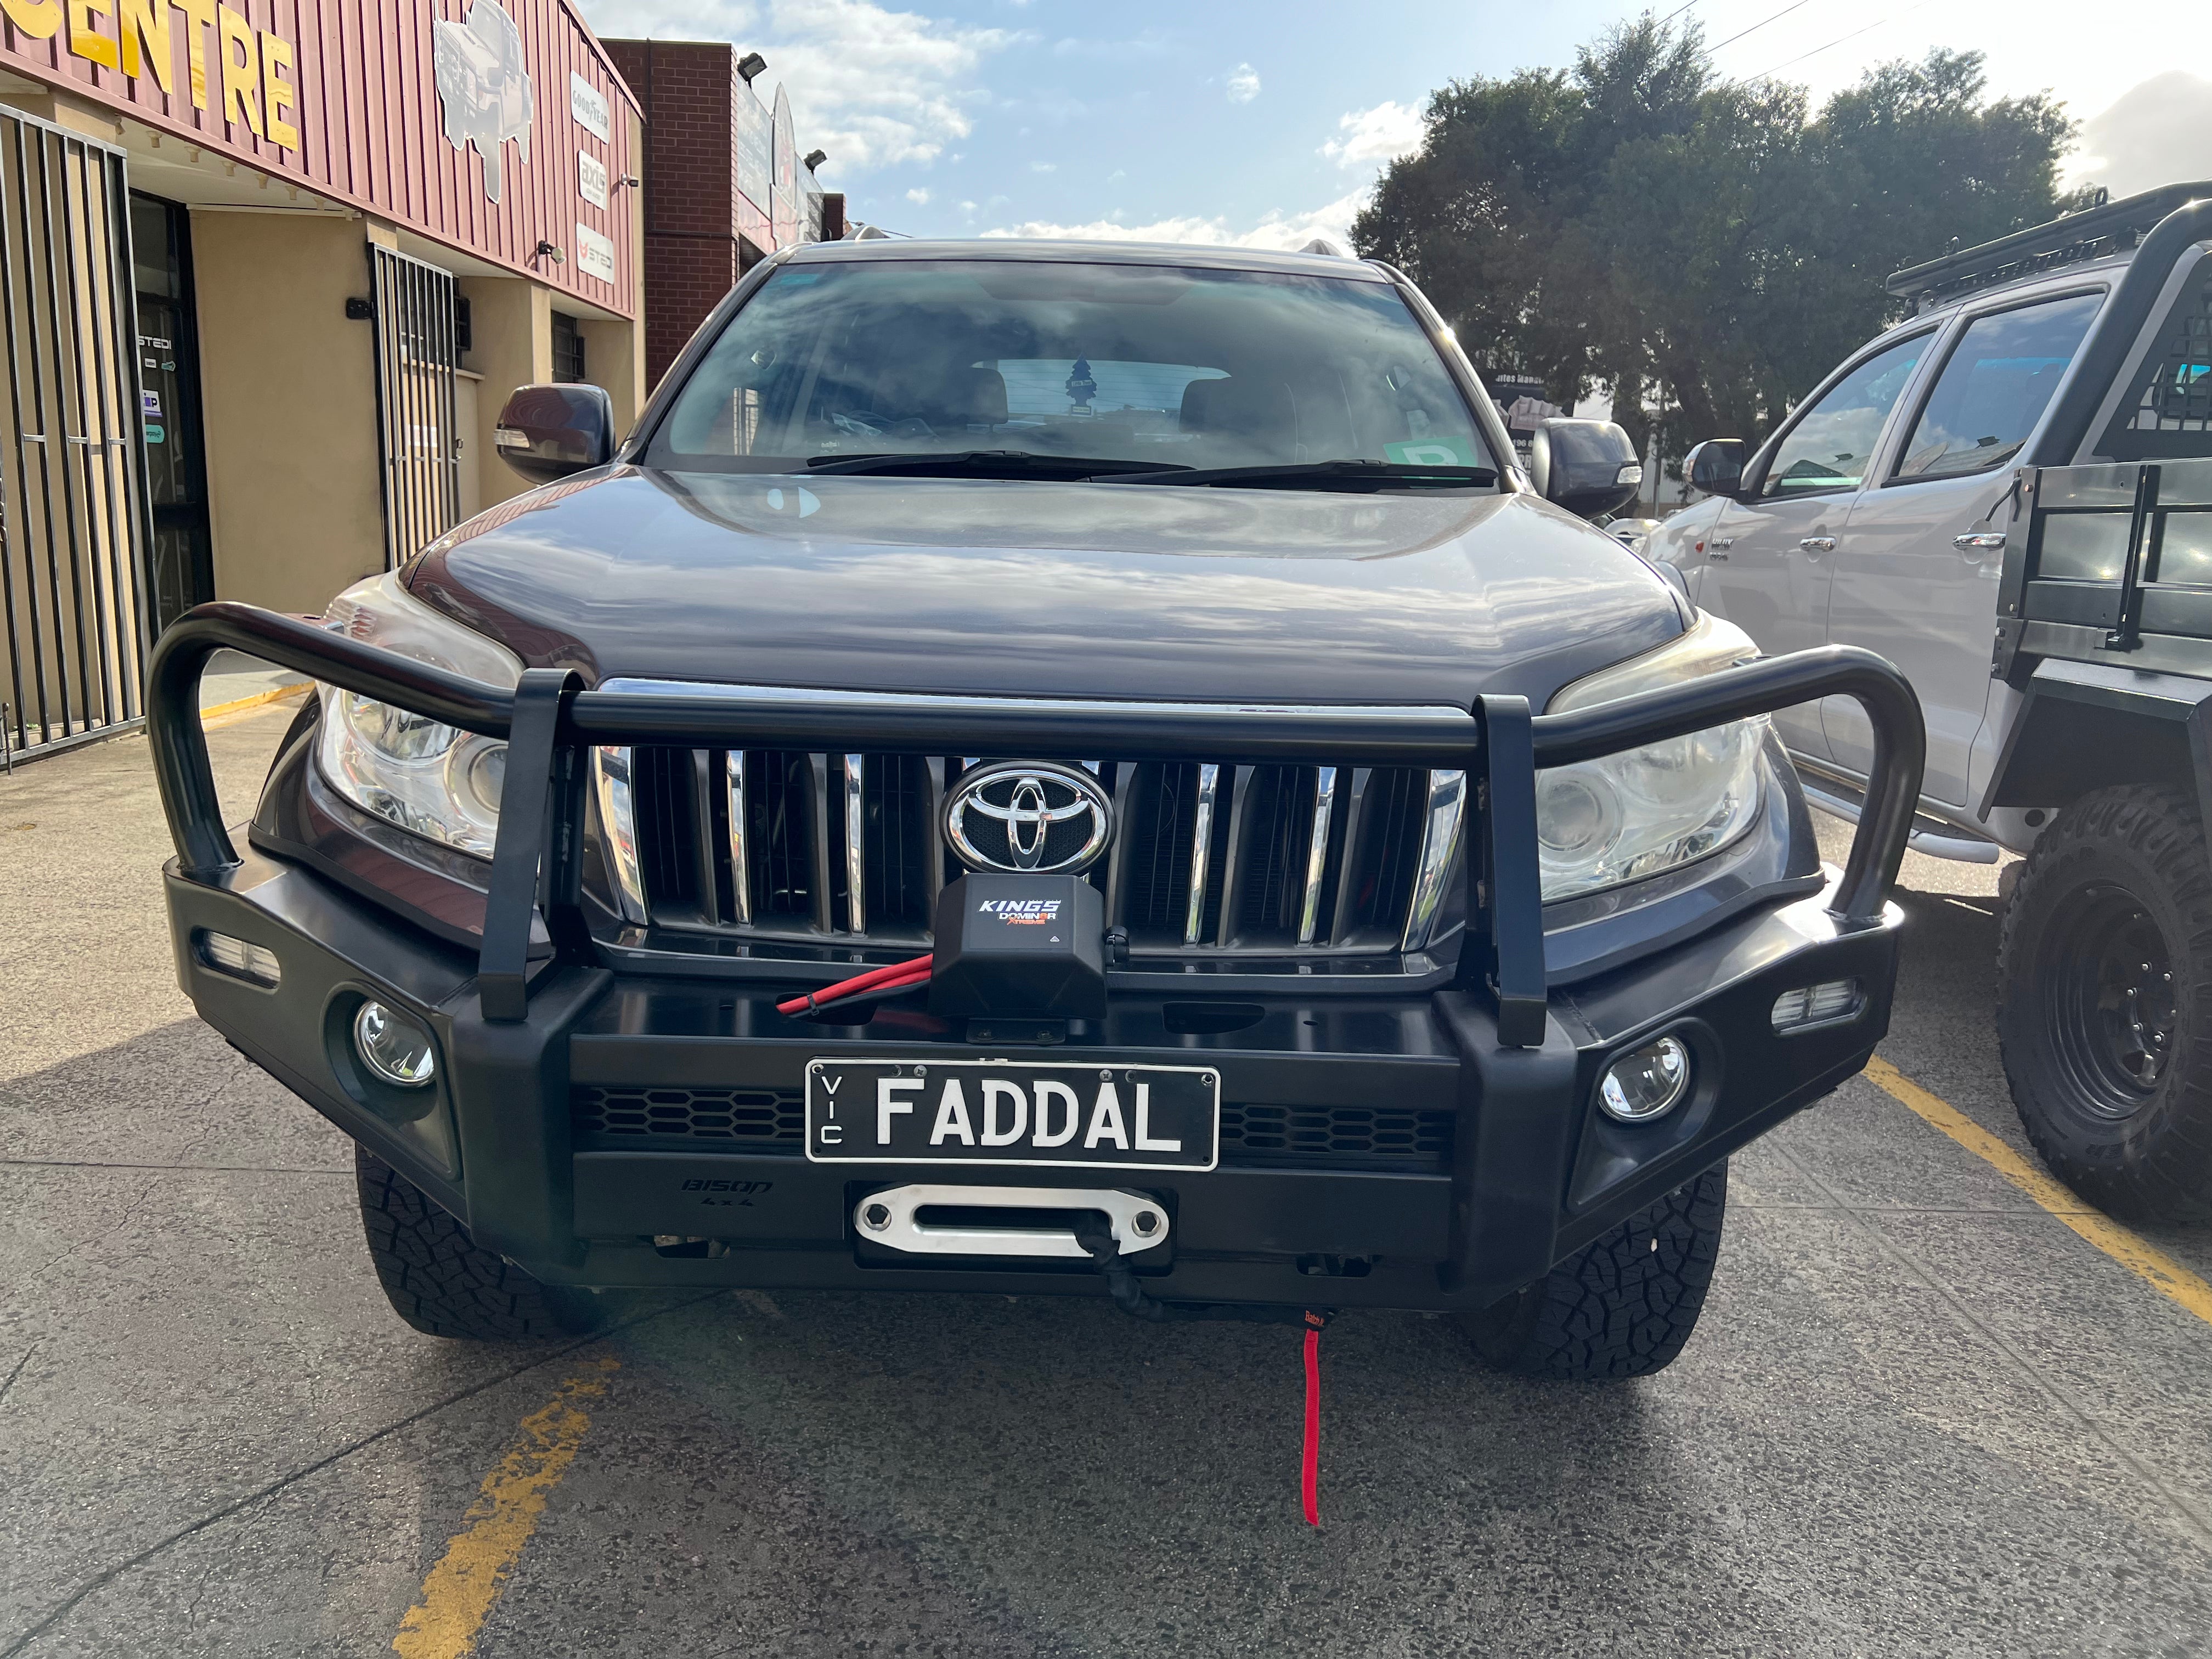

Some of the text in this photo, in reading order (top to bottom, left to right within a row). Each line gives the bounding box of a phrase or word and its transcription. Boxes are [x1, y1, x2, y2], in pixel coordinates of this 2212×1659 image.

[1, 0, 298, 151] ENTRE
[573, 90, 608, 129] GOODYEAR
[139, 335, 172, 349] STEDI
[979, 900, 1062, 912] KINGS
[877, 1077, 1181, 1152] FADDAL
[681, 1179, 773, 1195] BISON
